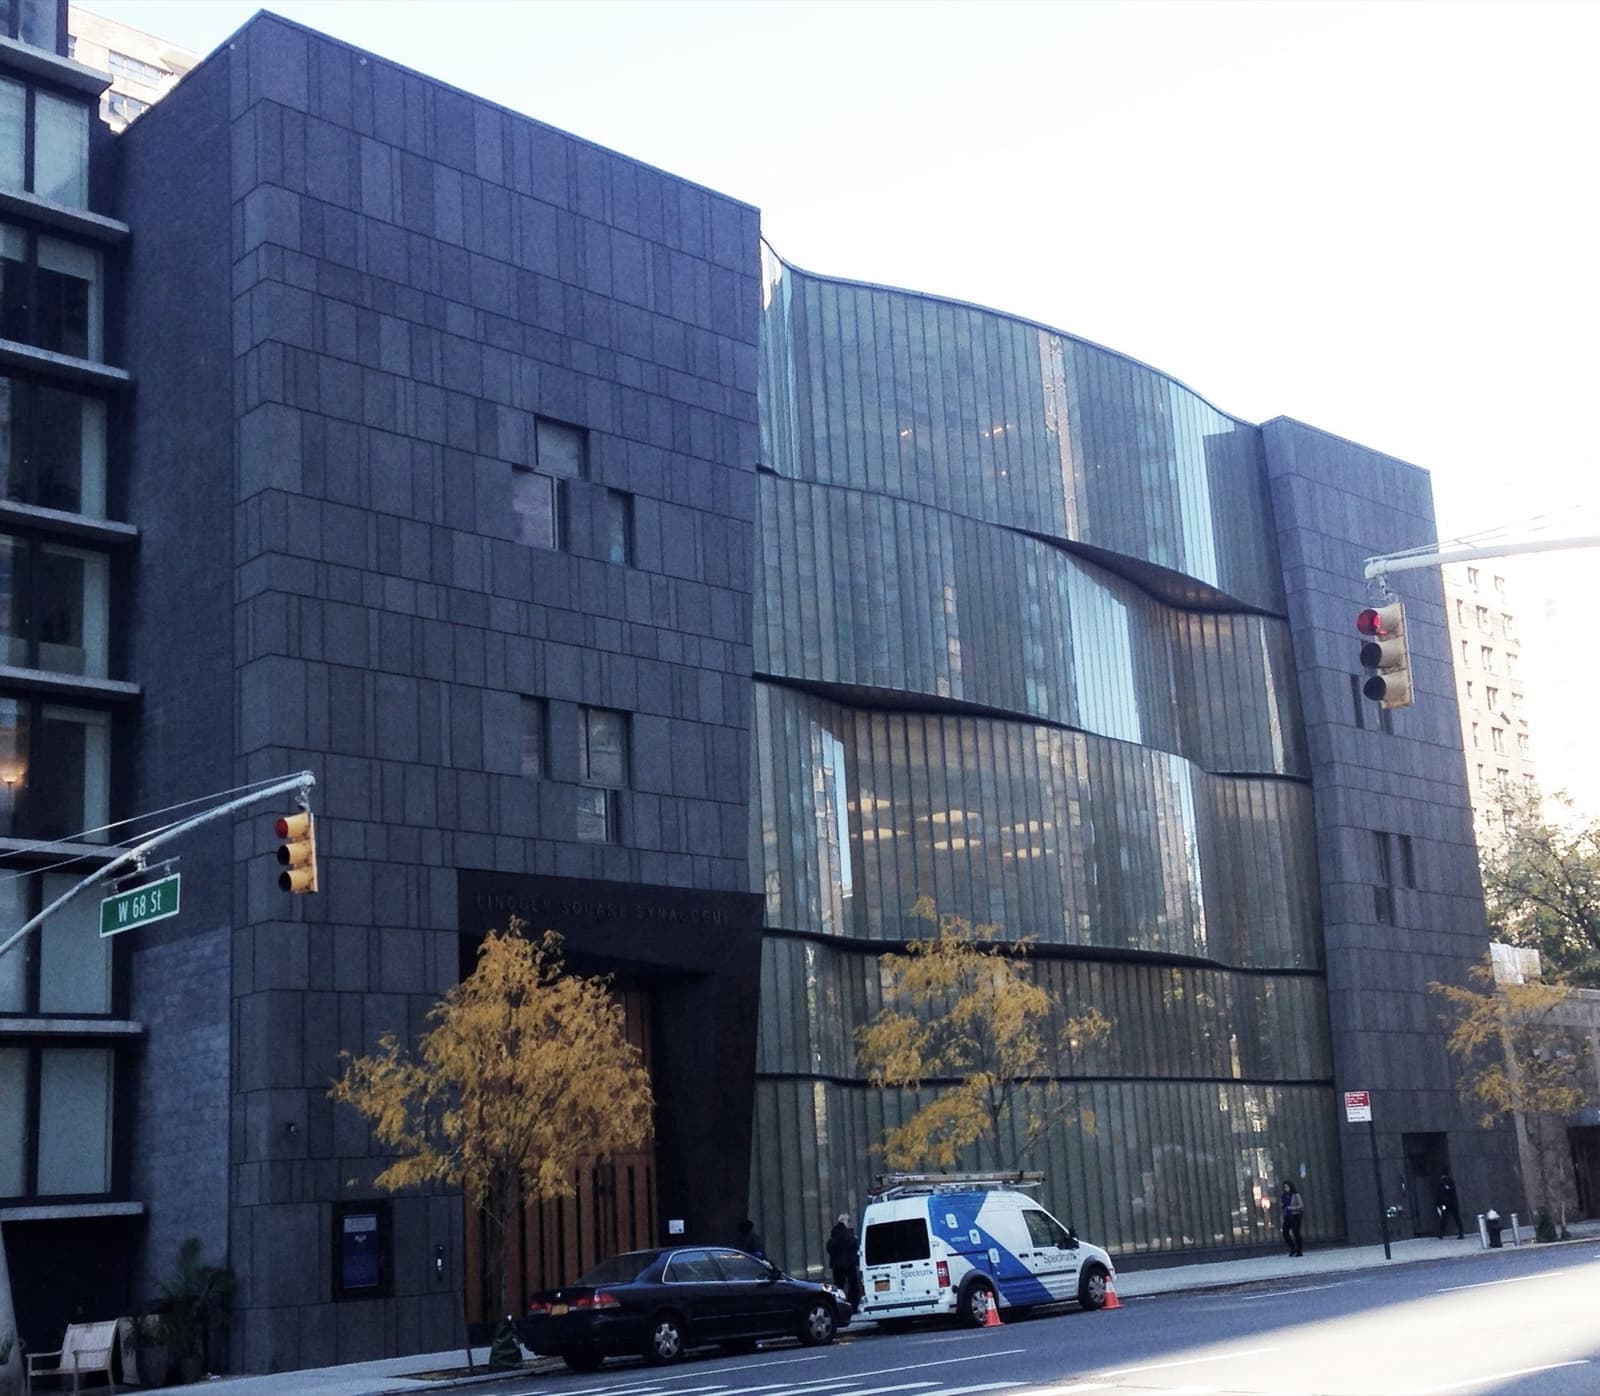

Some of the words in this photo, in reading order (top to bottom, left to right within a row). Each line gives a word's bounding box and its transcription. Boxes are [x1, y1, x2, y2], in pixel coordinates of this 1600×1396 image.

[118, 900, 129, 923] W
[132, 894, 146, 919] 68
[150, 888, 161, 913] St
[477, 895, 552, 913] LINCOLN
[1043, 1252, 1075, 1264] Spectrum
[900, 1268, 931, 1279] Spectrum
